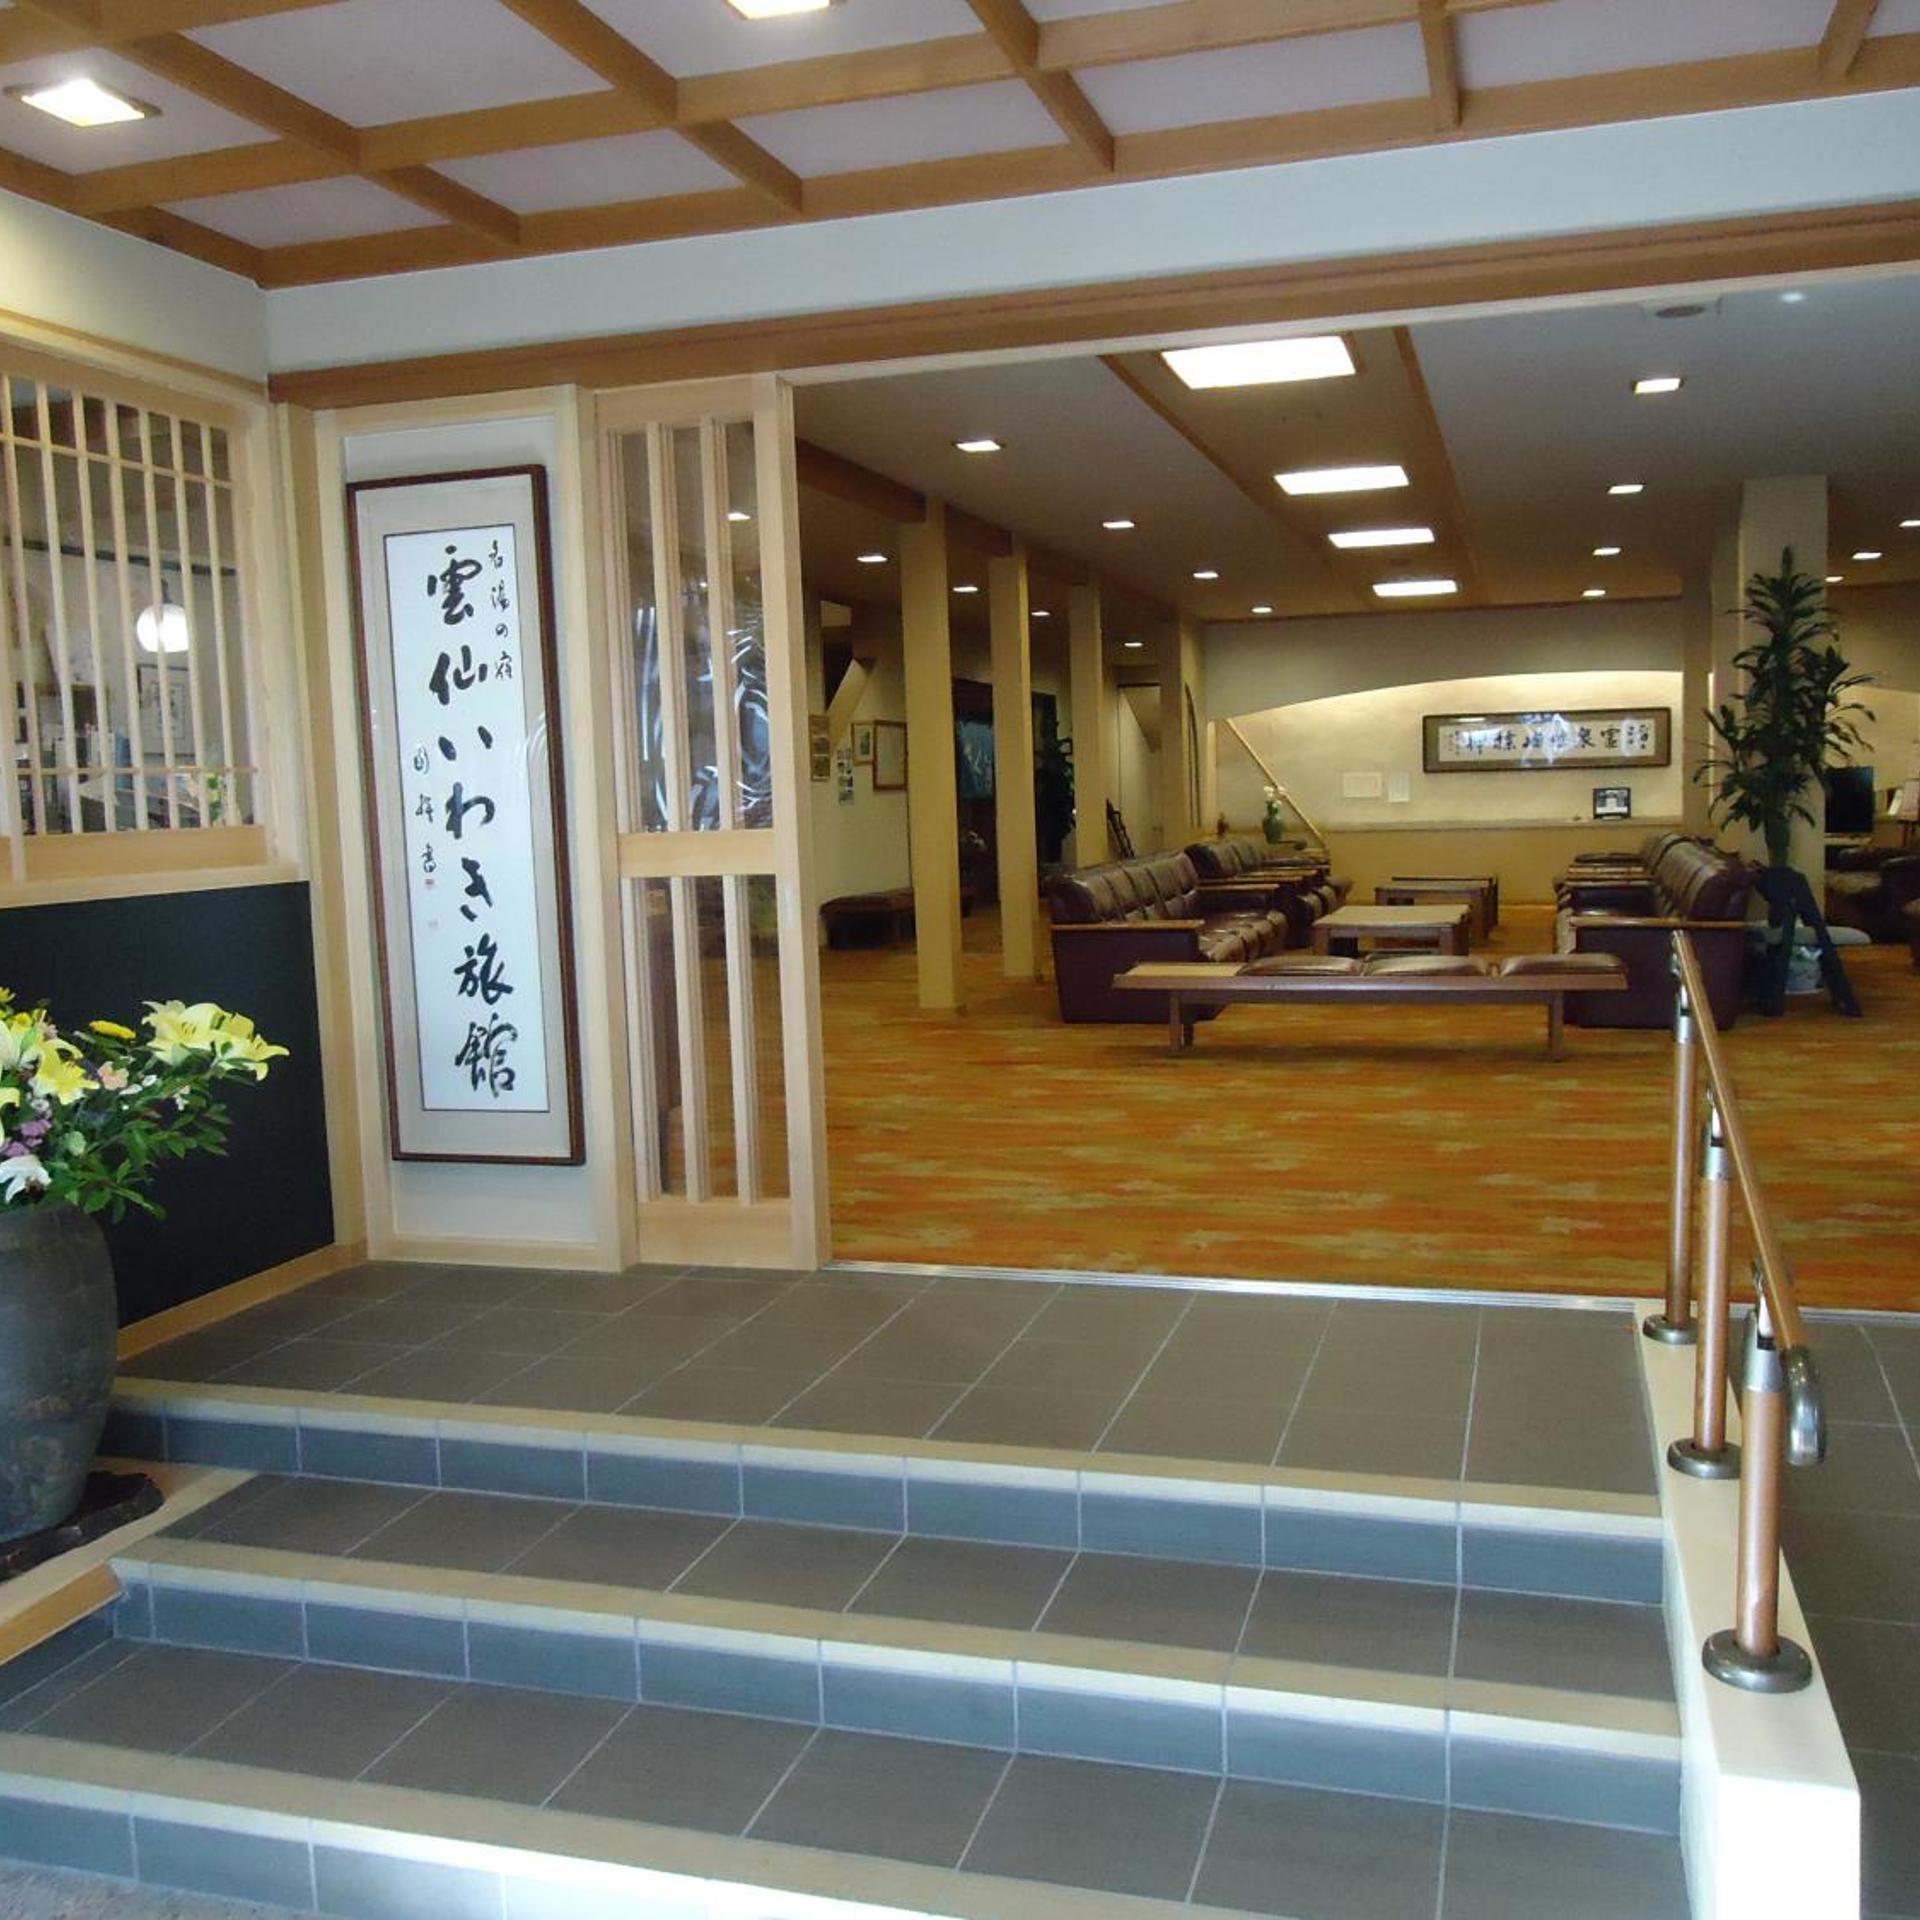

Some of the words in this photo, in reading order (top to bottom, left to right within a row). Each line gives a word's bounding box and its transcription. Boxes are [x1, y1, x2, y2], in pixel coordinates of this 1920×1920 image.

[427, 546, 518, 1097] 雲仙いわき旅館
